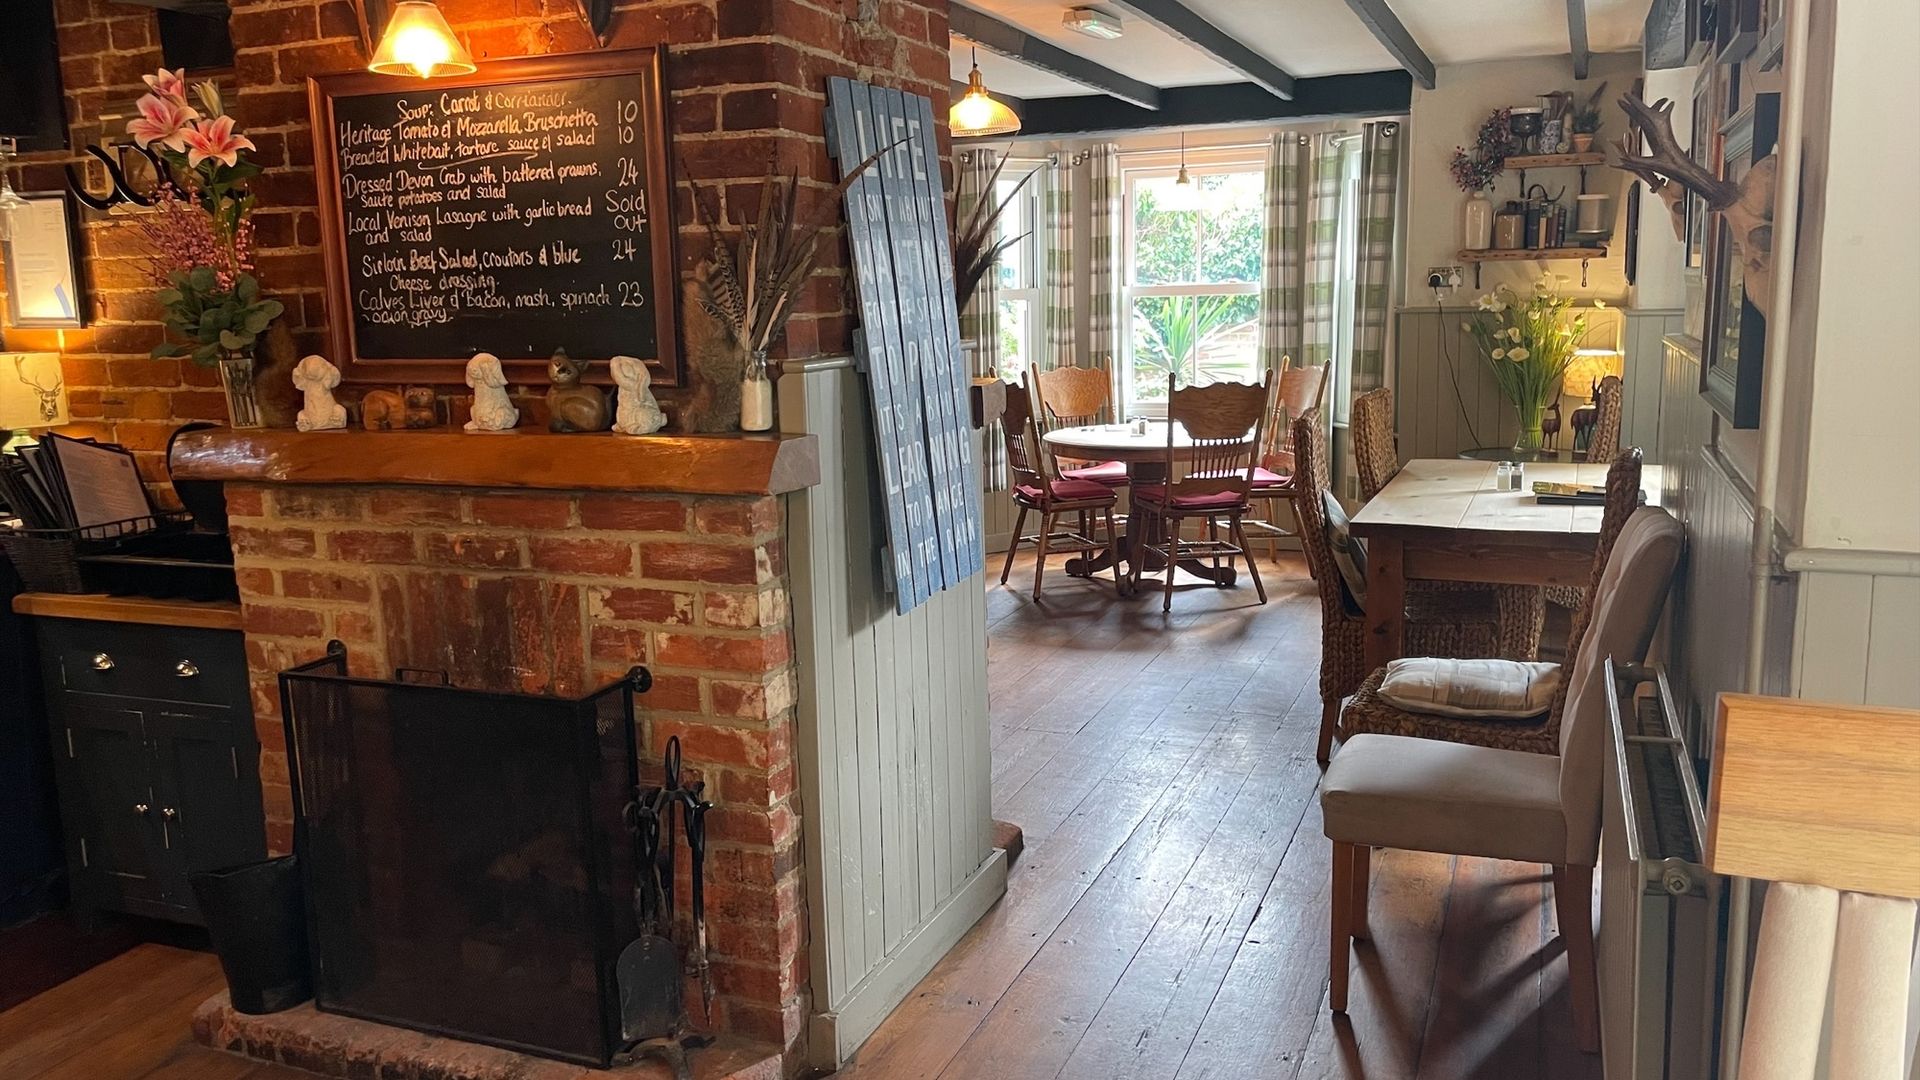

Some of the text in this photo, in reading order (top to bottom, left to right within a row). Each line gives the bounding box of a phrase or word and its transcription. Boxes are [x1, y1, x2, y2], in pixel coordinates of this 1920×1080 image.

[397, 100, 434, 121] Soup:
[440, 90, 481, 115] Carrot
[617, 100, 638, 124] 10
[340, 121, 392, 148] Heritage
[393, 118, 439, 140] Tomato
[457, 115, 523, 138] Mozzarella
[523, 108, 598, 132] Bruschetta
[618, 125, 634, 144] 10
[341, 146, 389, 171] Breaded
[455, 139, 499, 157] tartare
[508, 136, 540, 151] sauce
[557, 127, 595, 146] salad
[857, 110, 927, 181] LIFE
[342, 172, 392, 199] Dressed
[396, 169, 434, 191] Devon
[439, 167, 466, 185] Crab
[470, 166, 497, 184] with
[503, 160, 554, 183] battered
[618, 157, 638, 187] 24
[399, 191, 443, 210] potatoes
[447, 185, 470, 201] and
[476, 183, 506, 199] salad
[605, 189, 646, 214] Sold
[898, 195, 936, 222] ABOUT
[348, 196, 592, 235] Local Venison Lasagne with garlic bread
[365, 227, 432, 245] and salad
[612, 238, 637, 262] 24
[362, 250, 407, 277] Sirloin
[410, 249, 437, 274] Beef
[482, 246, 533, 268] croutons
[552, 240, 581, 265] blue
[856, 237, 953, 285] WAITING
[359, 288, 406, 311] Calves
[410, 290, 445, 309] Liver
[560, 283, 612, 311] spinach
[618, 281, 644, 307] 23
[865, 301, 888, 330] FOR
[890, 298, 913, 326] THE
[871, 345, 899, 389] TO
[915, 388, 960, 425] ABOUT
[885, 425, 971, 495] LEARNING
[906, 482, 965, 529] TO DANCE
[897, 517, 976, 580] IN THE RAIN
